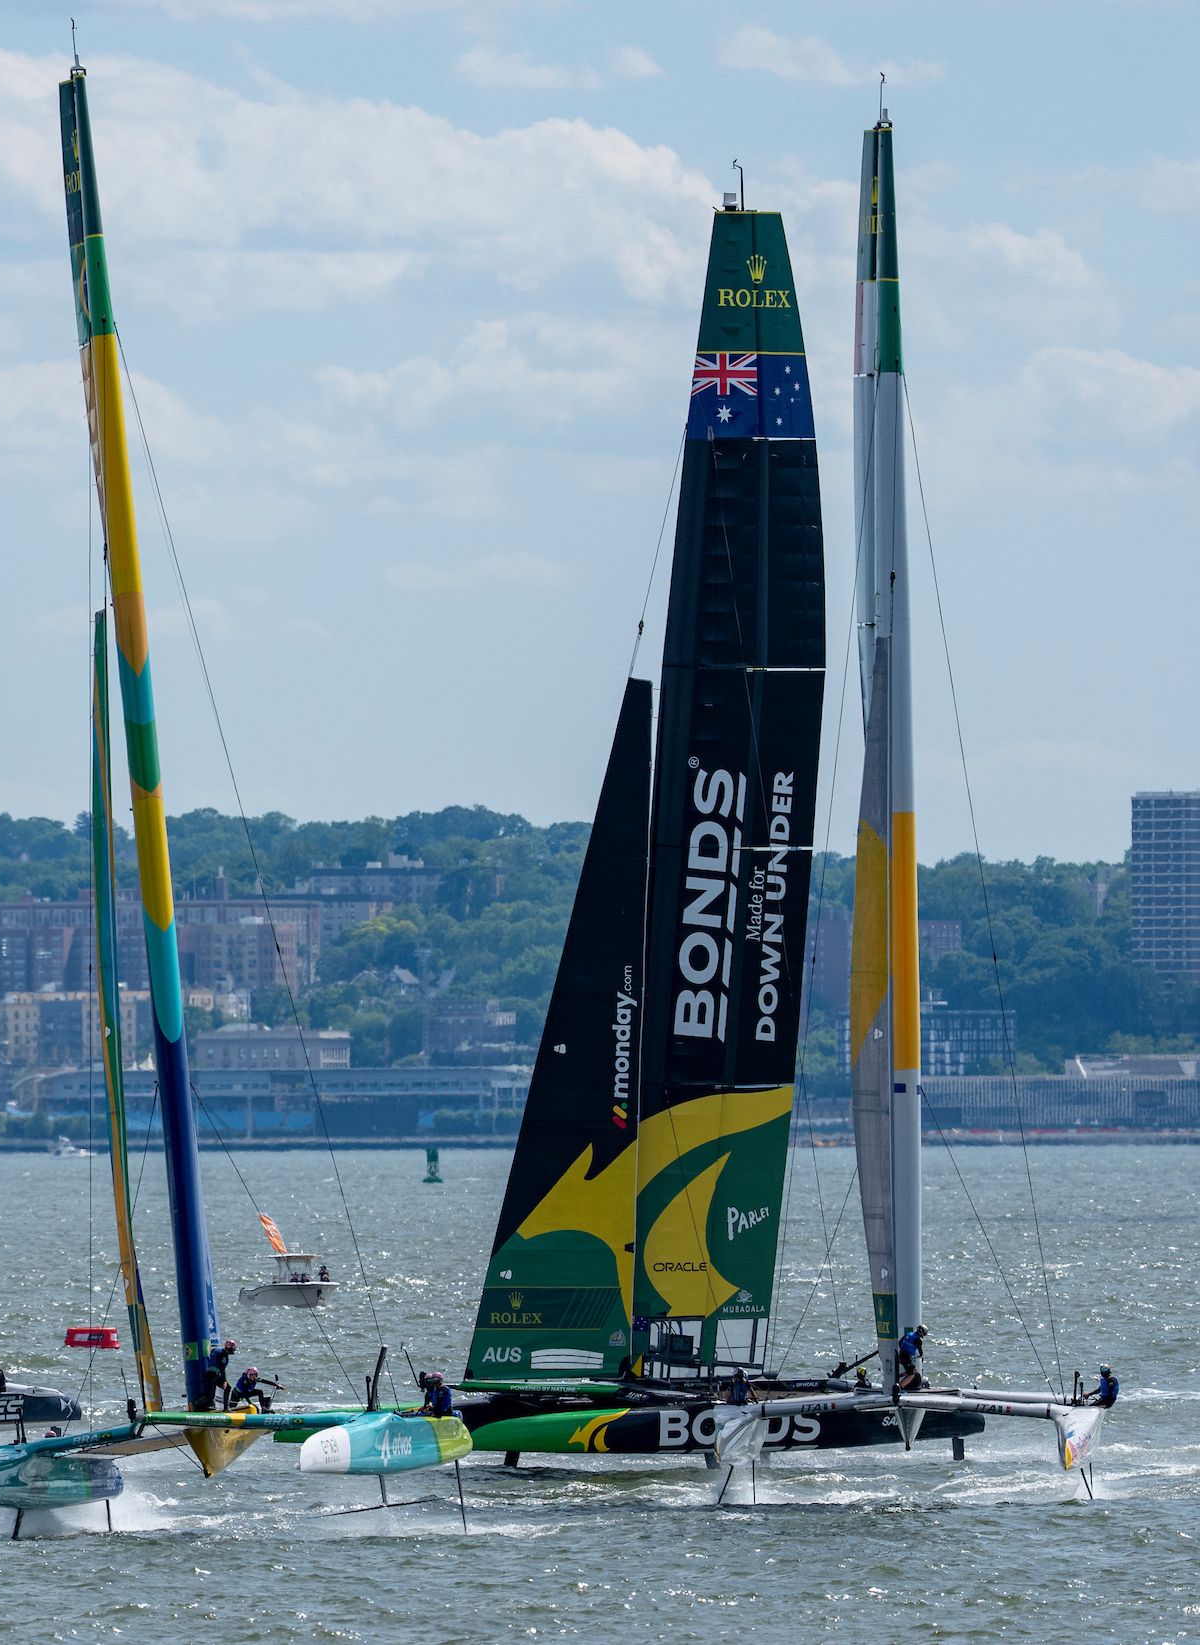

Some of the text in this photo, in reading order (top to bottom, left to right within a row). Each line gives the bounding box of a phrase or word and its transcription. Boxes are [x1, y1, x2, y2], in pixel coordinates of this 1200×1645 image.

[717, 288, 791, 308] ROLEX
[745, 866, 766, 942] Made for
[755, 771, 794, 1042] DOWN UNDER
[612, 965, 638, 1099] monday.com
[727, 1206, 770, 1241] PARLEY
[653, 1262, 707, 1272] ORACLE
[722, 1304, 765, 1314] MUBADALA
[490, 1312, 542, 1324] ROLEX
[481, 1347, 522, 1363] AUS
[801, 1403, 823, 1413] ITA
[975, 1403, 998, 1413] ITA
[263, 1417, 290, 1426] BRA
[659, 1410, 821, 1446] BODS
[72, 1433, 99, 1446] BRA
